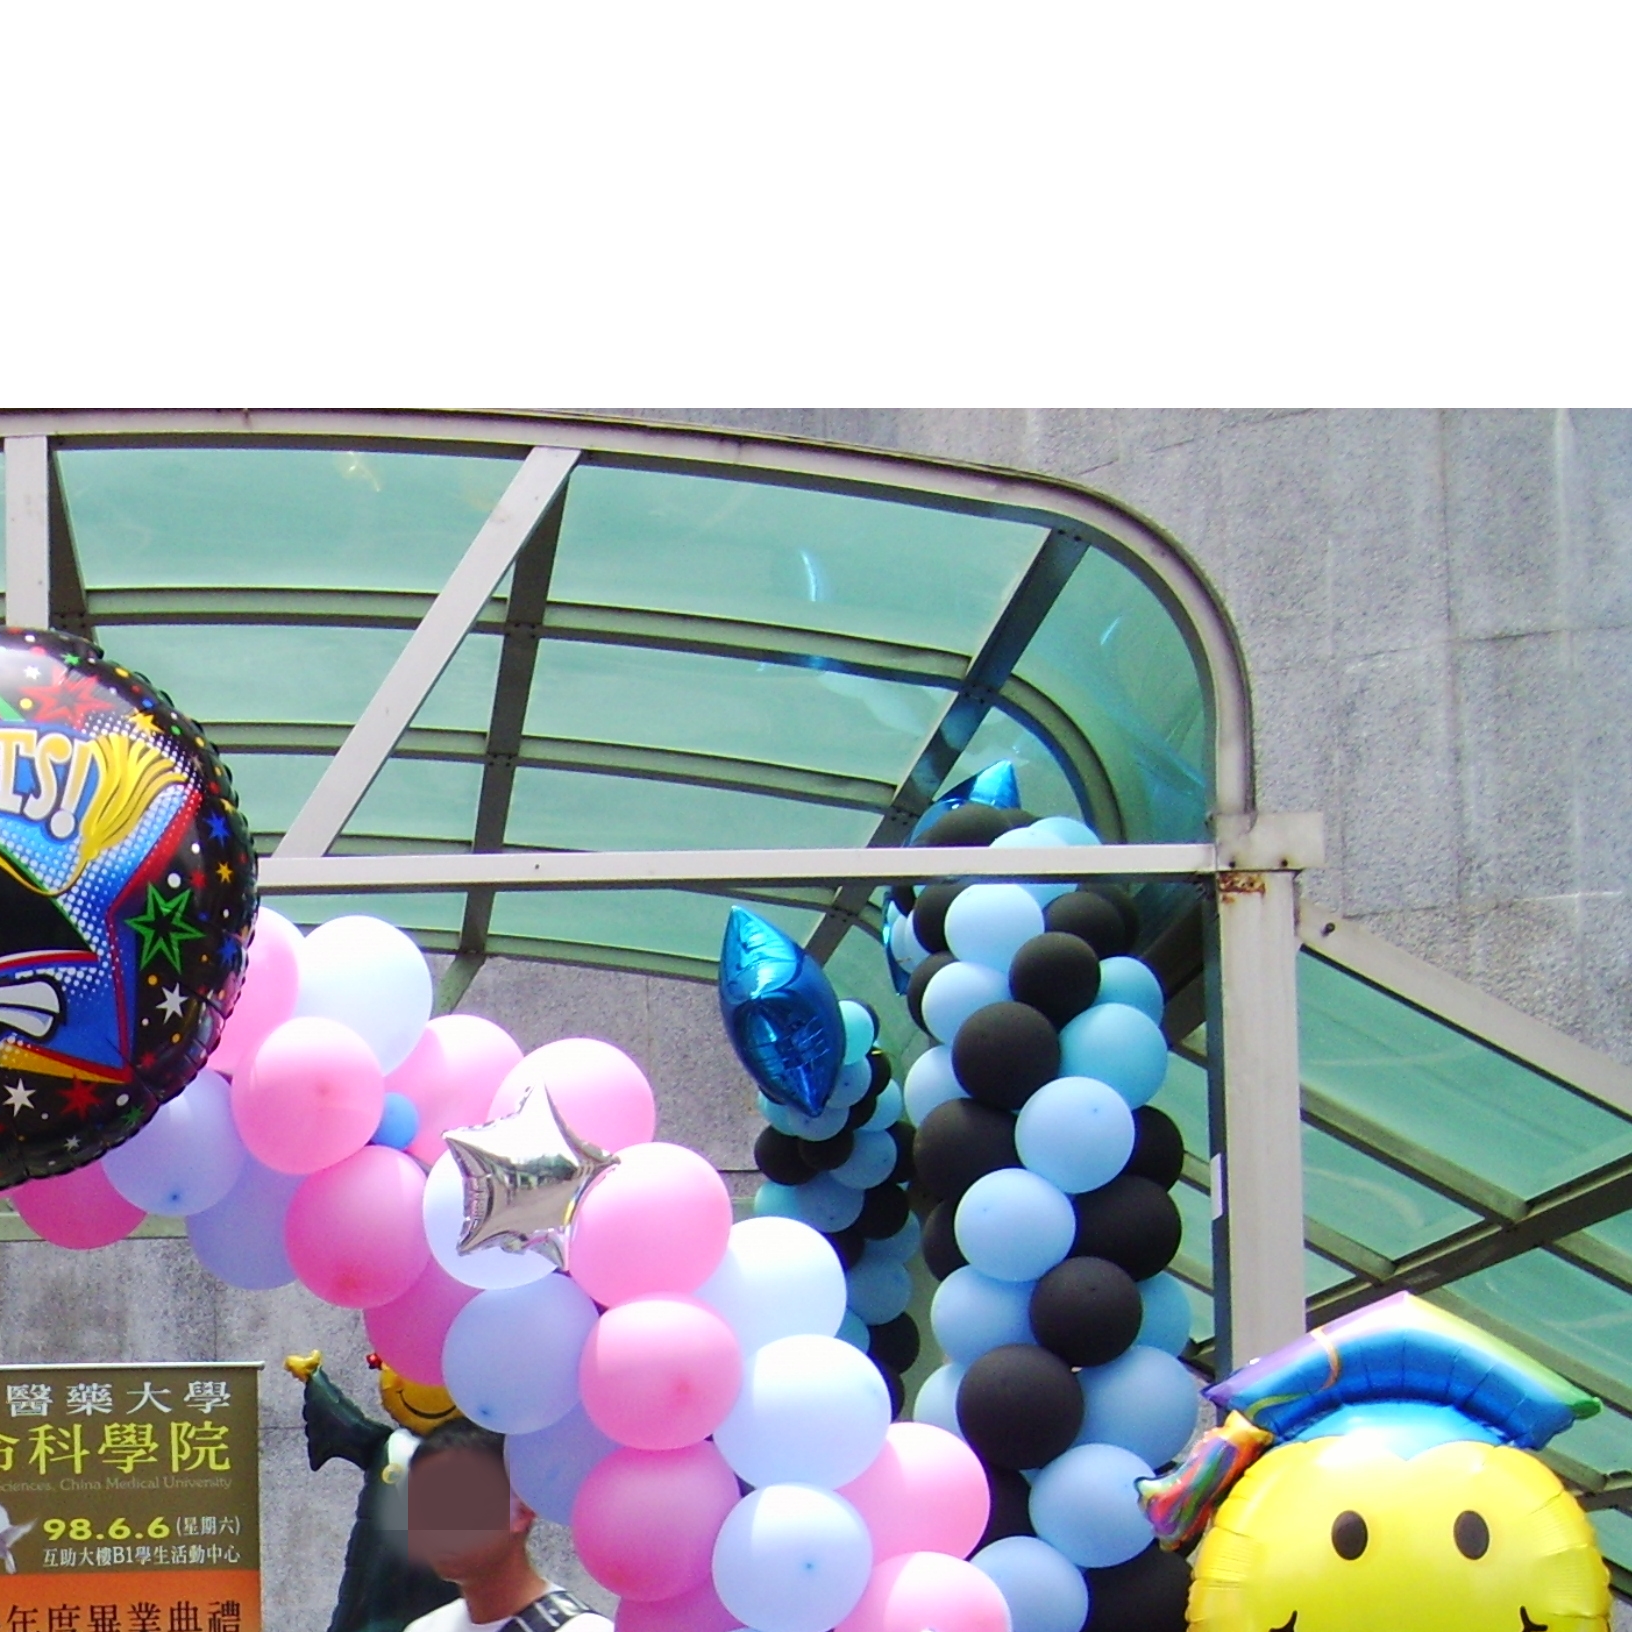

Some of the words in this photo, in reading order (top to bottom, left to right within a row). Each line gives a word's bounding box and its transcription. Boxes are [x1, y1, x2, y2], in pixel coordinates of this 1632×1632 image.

[59, 1478, 101, 1491] China
[105, 1476, 160, 1490] Medical
[163, 1476, 232, 1490] University
[43, 1516, 170, 1541] 98.6.6
[43, 1543, 241, 1567] 互助大樓B1學生活動中心
